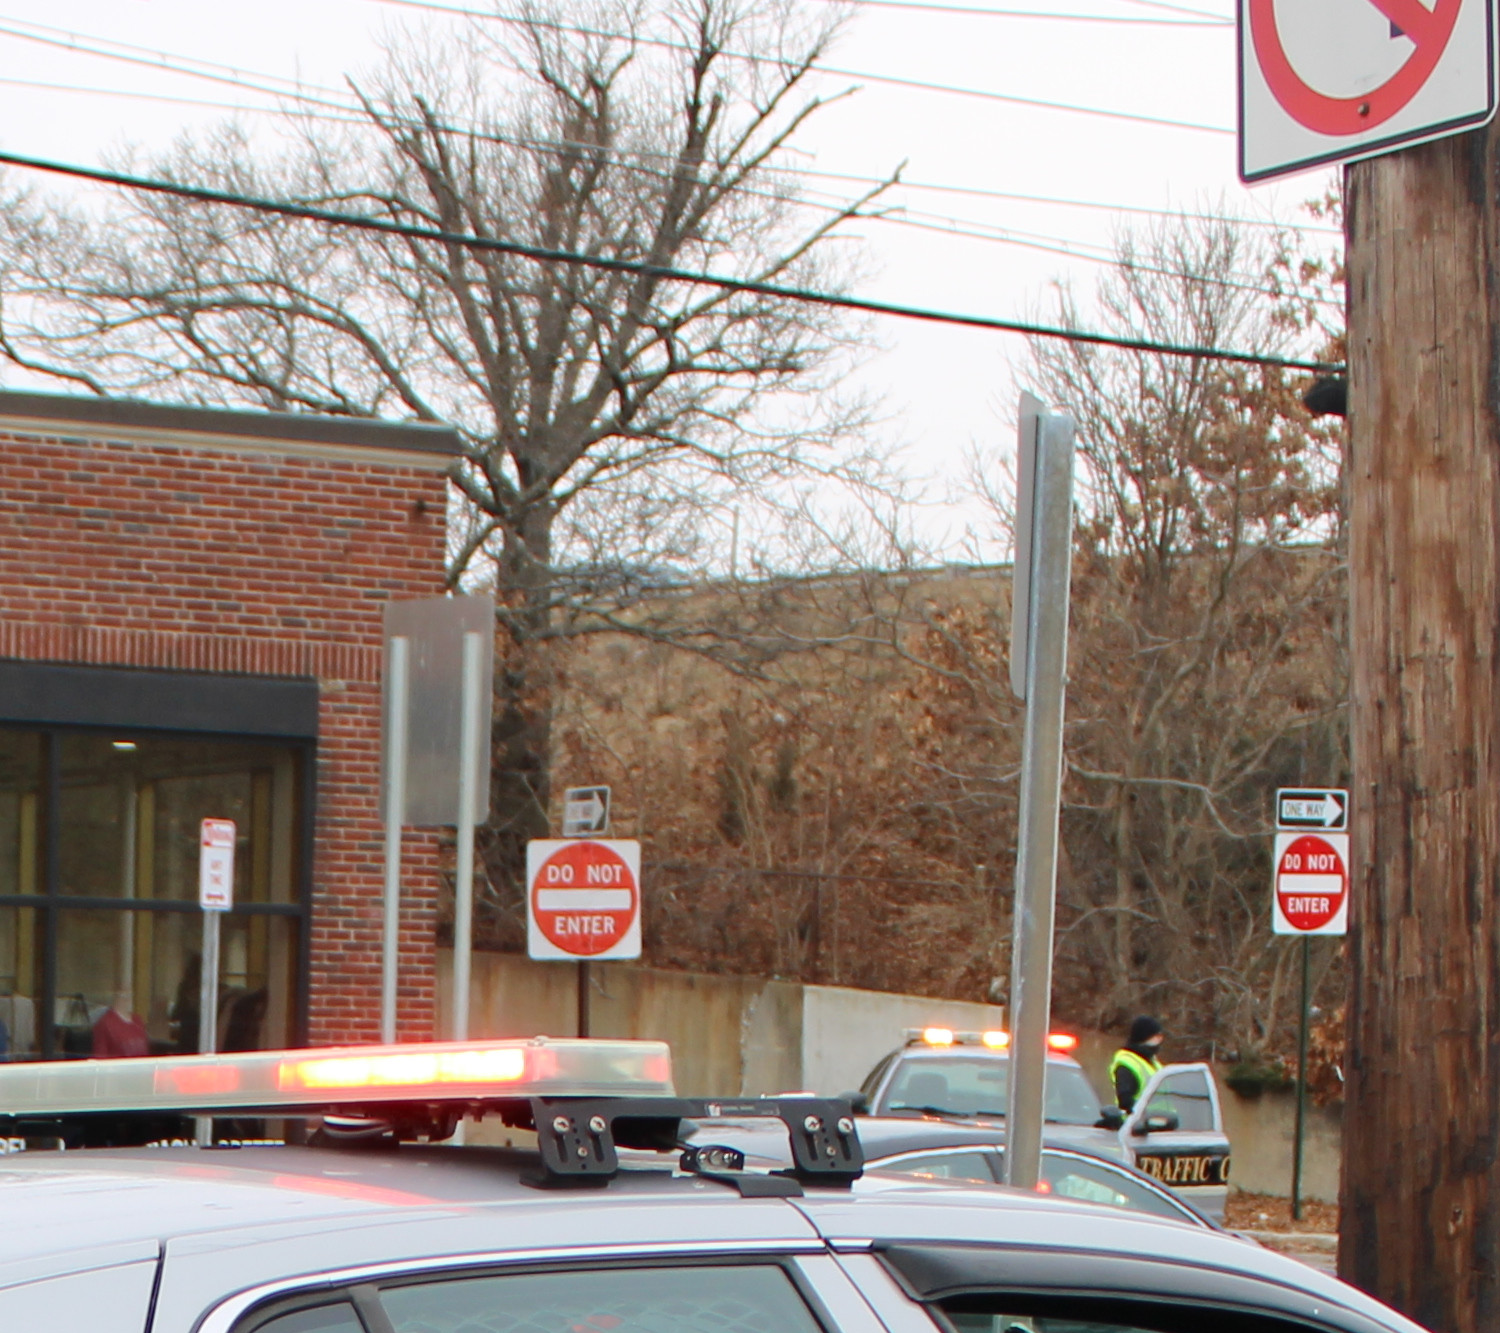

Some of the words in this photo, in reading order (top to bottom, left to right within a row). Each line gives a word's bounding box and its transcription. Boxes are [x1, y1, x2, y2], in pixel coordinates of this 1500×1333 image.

[1284, 802, 1303, 817] ONE
[1305, 803, 1325, 817] WAY
[1284, 854, 1301, 870] DO
[1307, 854, 1336, 871] NOT
[547, 864, 574, 883] DO
[587, 864, 623, 884] NOT
[1287, 897, 1330, 914] ENTER
[554, 915, 615, 936] ENTER
[1139, 1156, 1212, 1182] TRAFFIC
